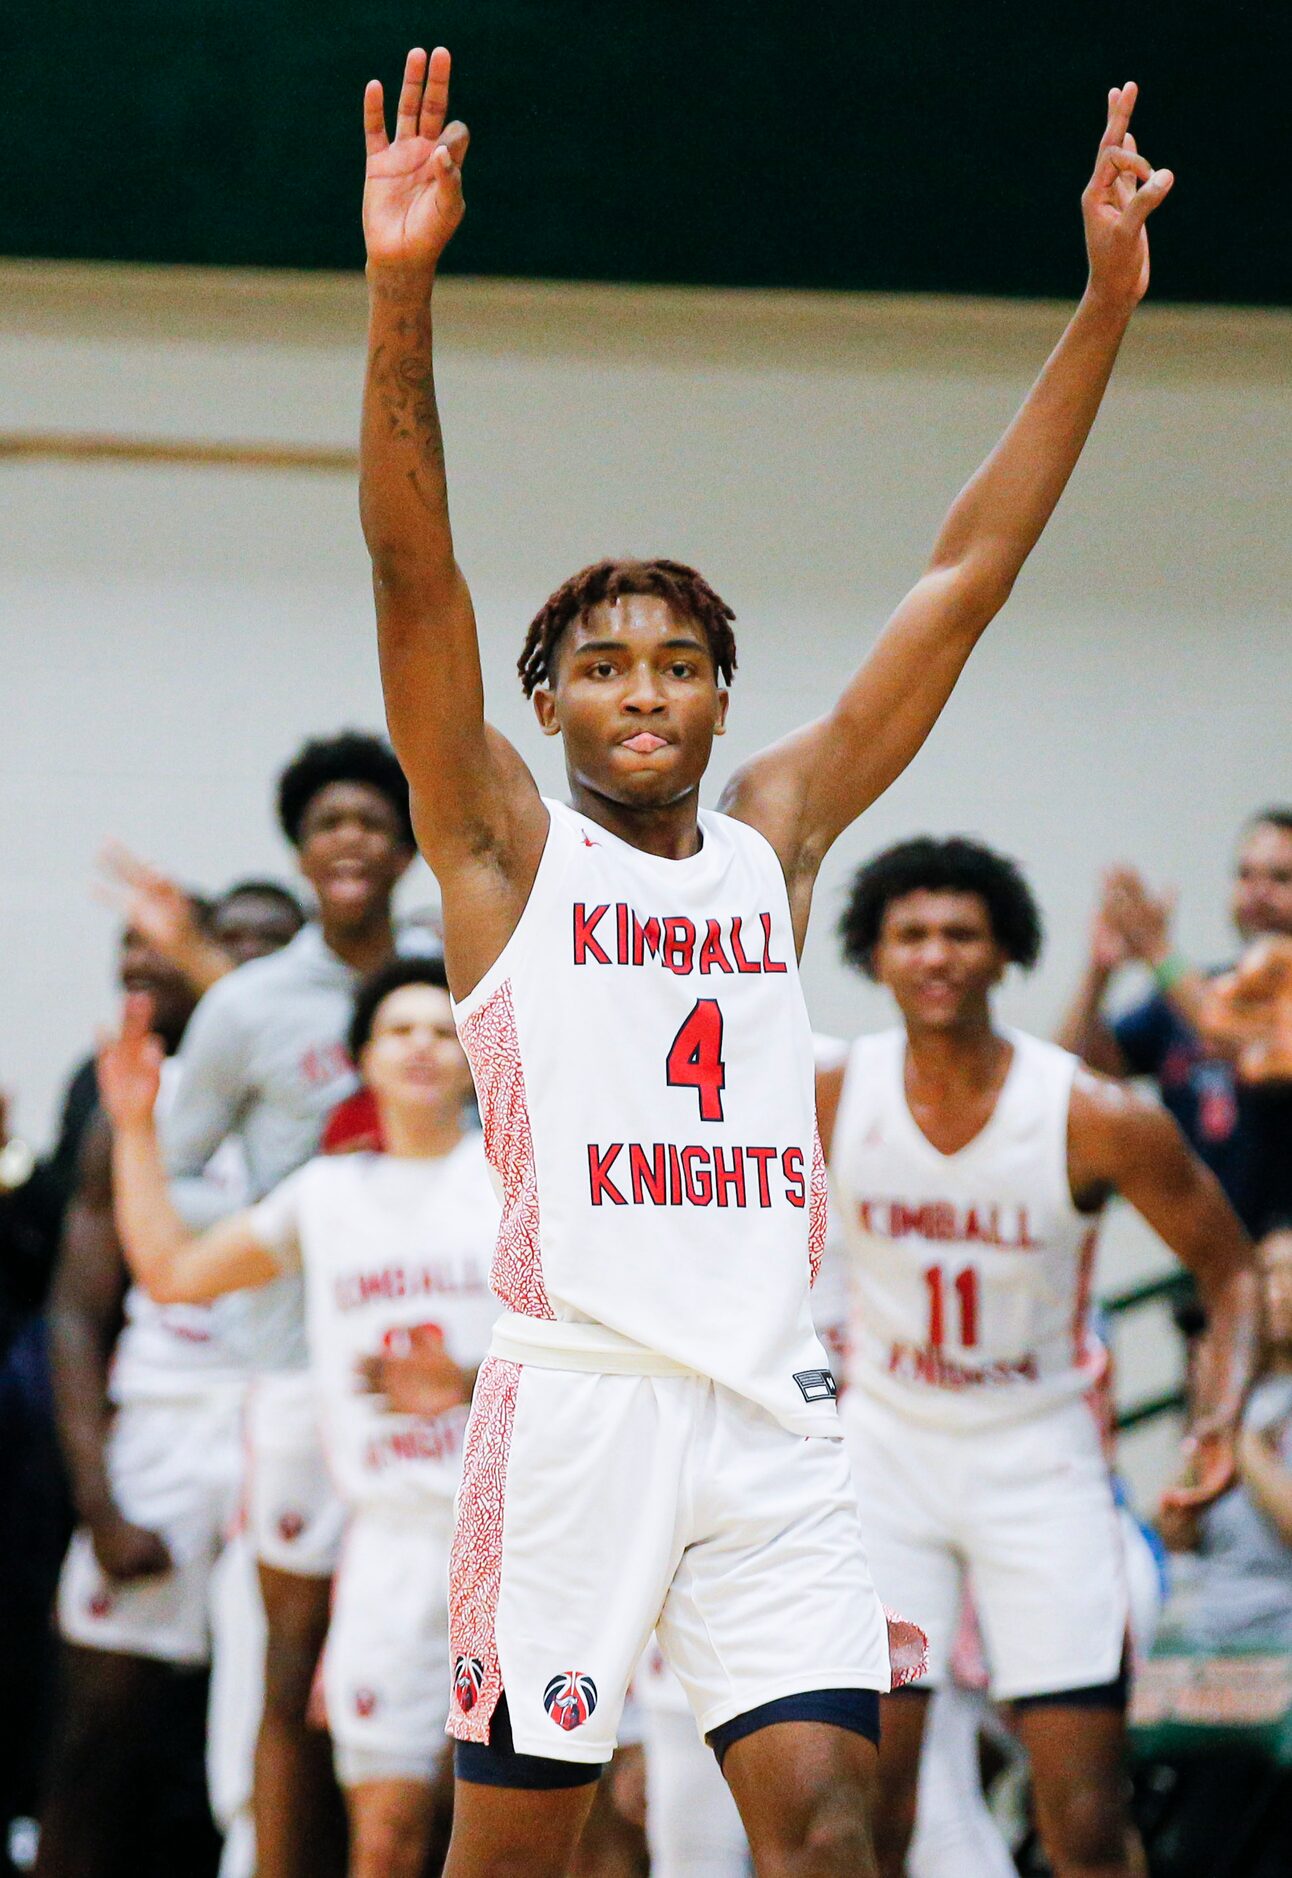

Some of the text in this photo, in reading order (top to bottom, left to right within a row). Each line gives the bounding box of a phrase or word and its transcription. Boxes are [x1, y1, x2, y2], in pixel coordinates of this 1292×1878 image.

[572, 902, 788, 975] KIMBALL
[666, 998, 725, 1122] 4
[587, 1143, 805, 1208] KNIGHTS
[924, 1265, 979, 1347] 11
